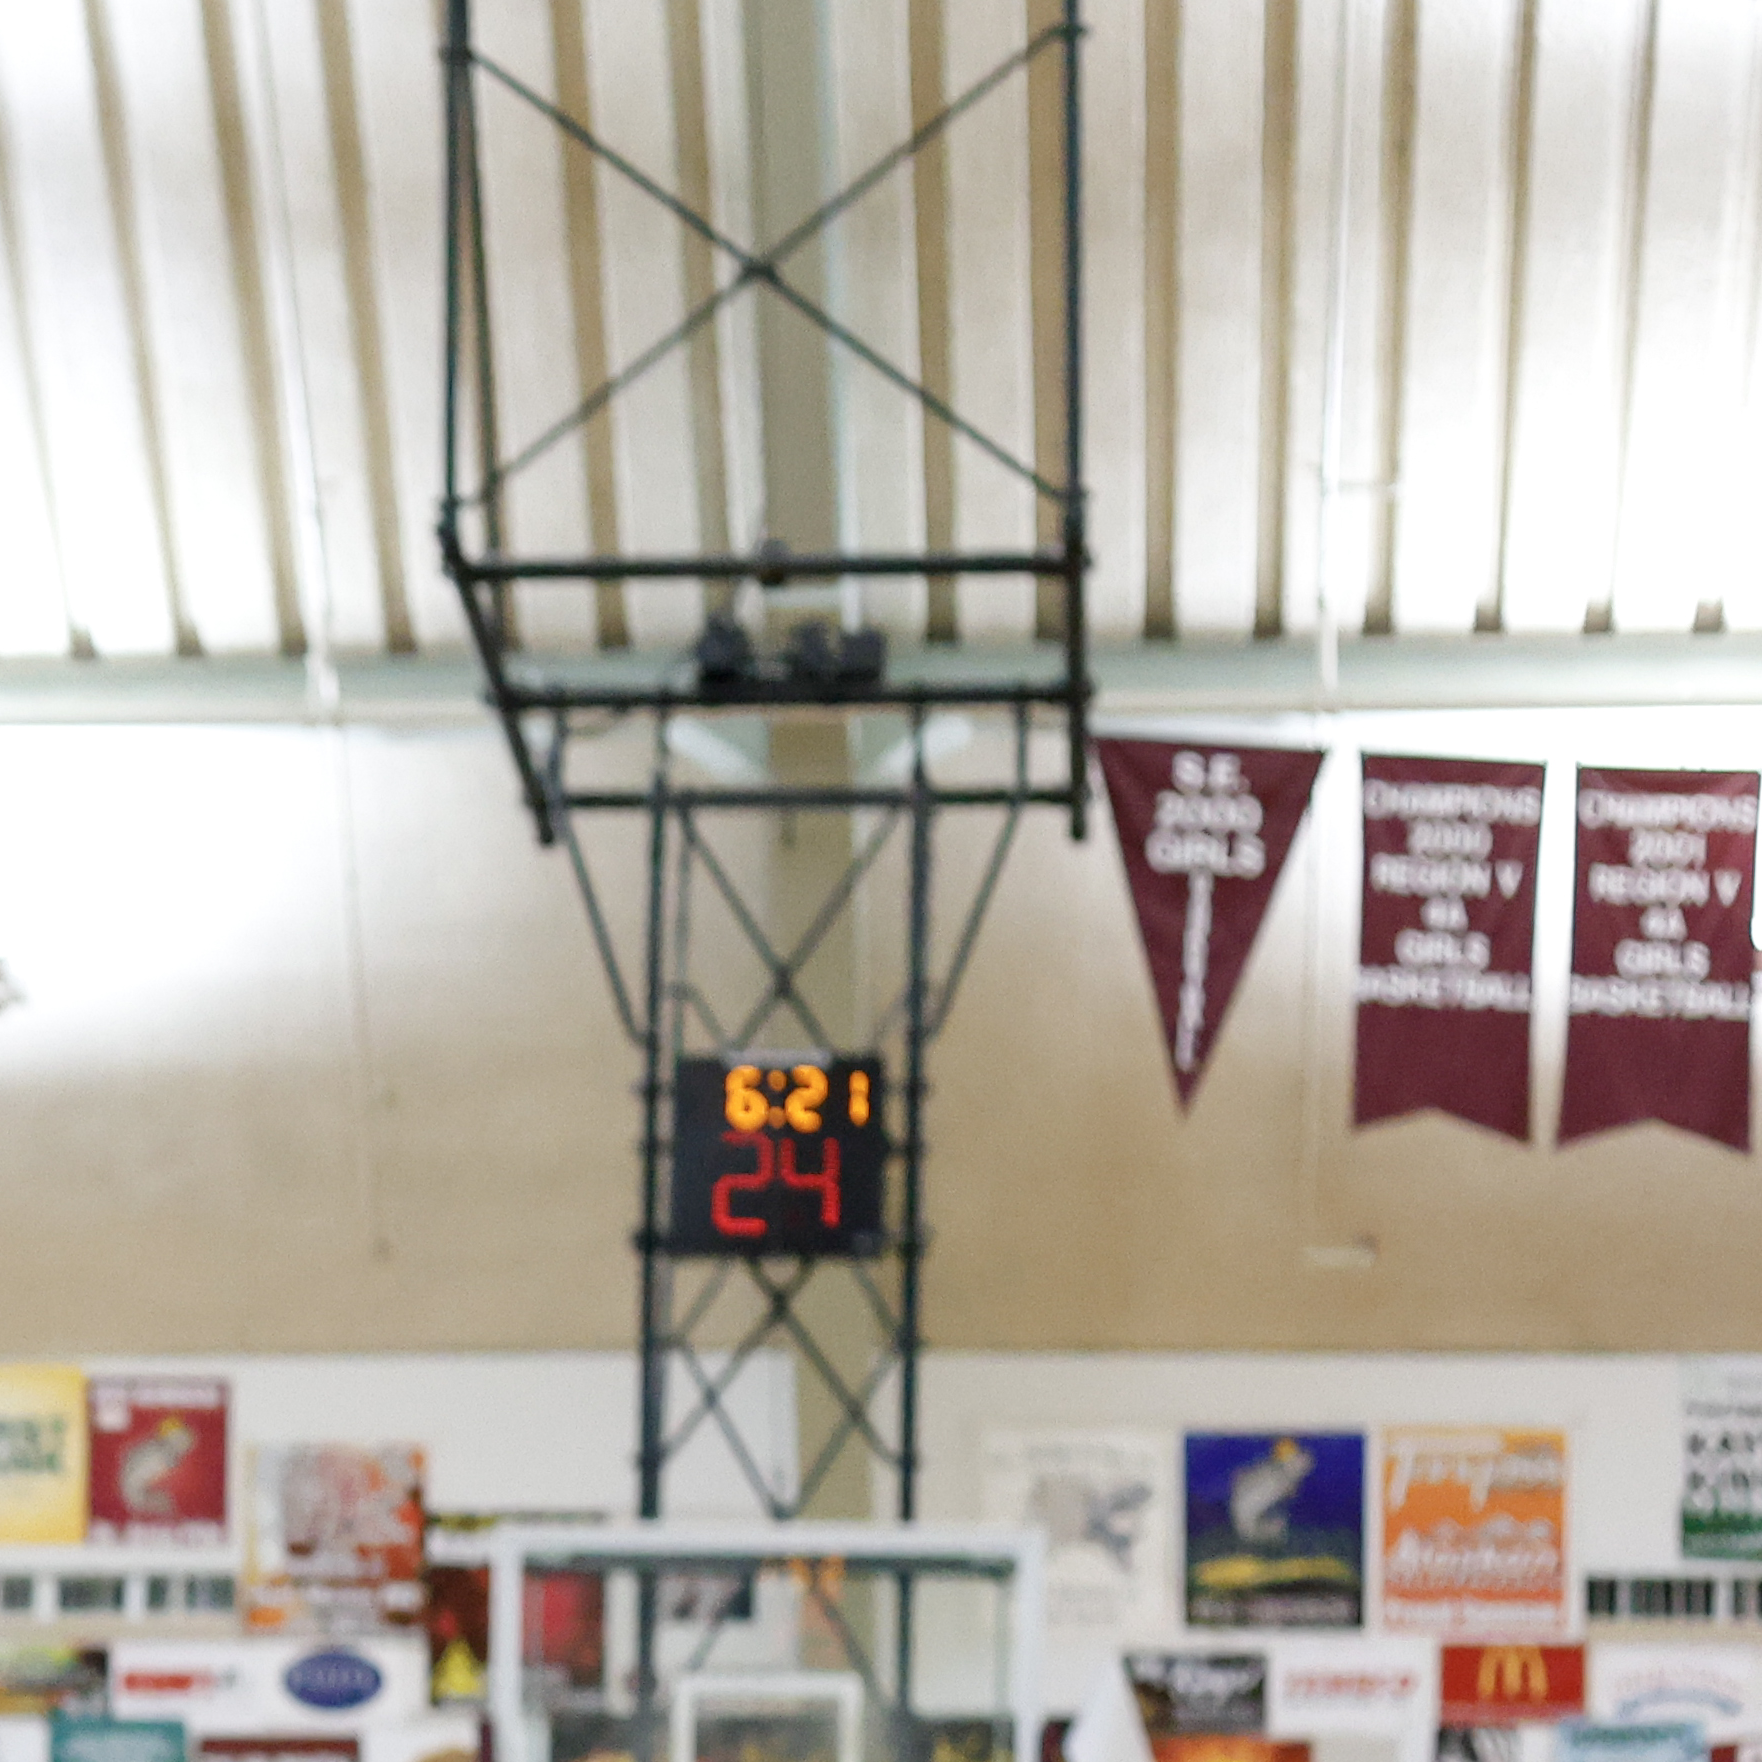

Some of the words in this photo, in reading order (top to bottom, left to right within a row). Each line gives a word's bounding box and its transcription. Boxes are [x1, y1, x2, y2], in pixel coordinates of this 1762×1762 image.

[1145, 829, 1265, 880] GIRLS
[1370, 853, 1492, 897] REGION
[1494, 859, 1524, 900] V
[1588, 862, 1710, 907] REGION
[1714, 868, 1743, 908] V
[1394, 927, 1491, 973] GIRLS
[1614, 938, 1711, 982] GIRLS
[725, 1064, 870, 1134] 6:21
[712, 1131, 841, 1238] 24
